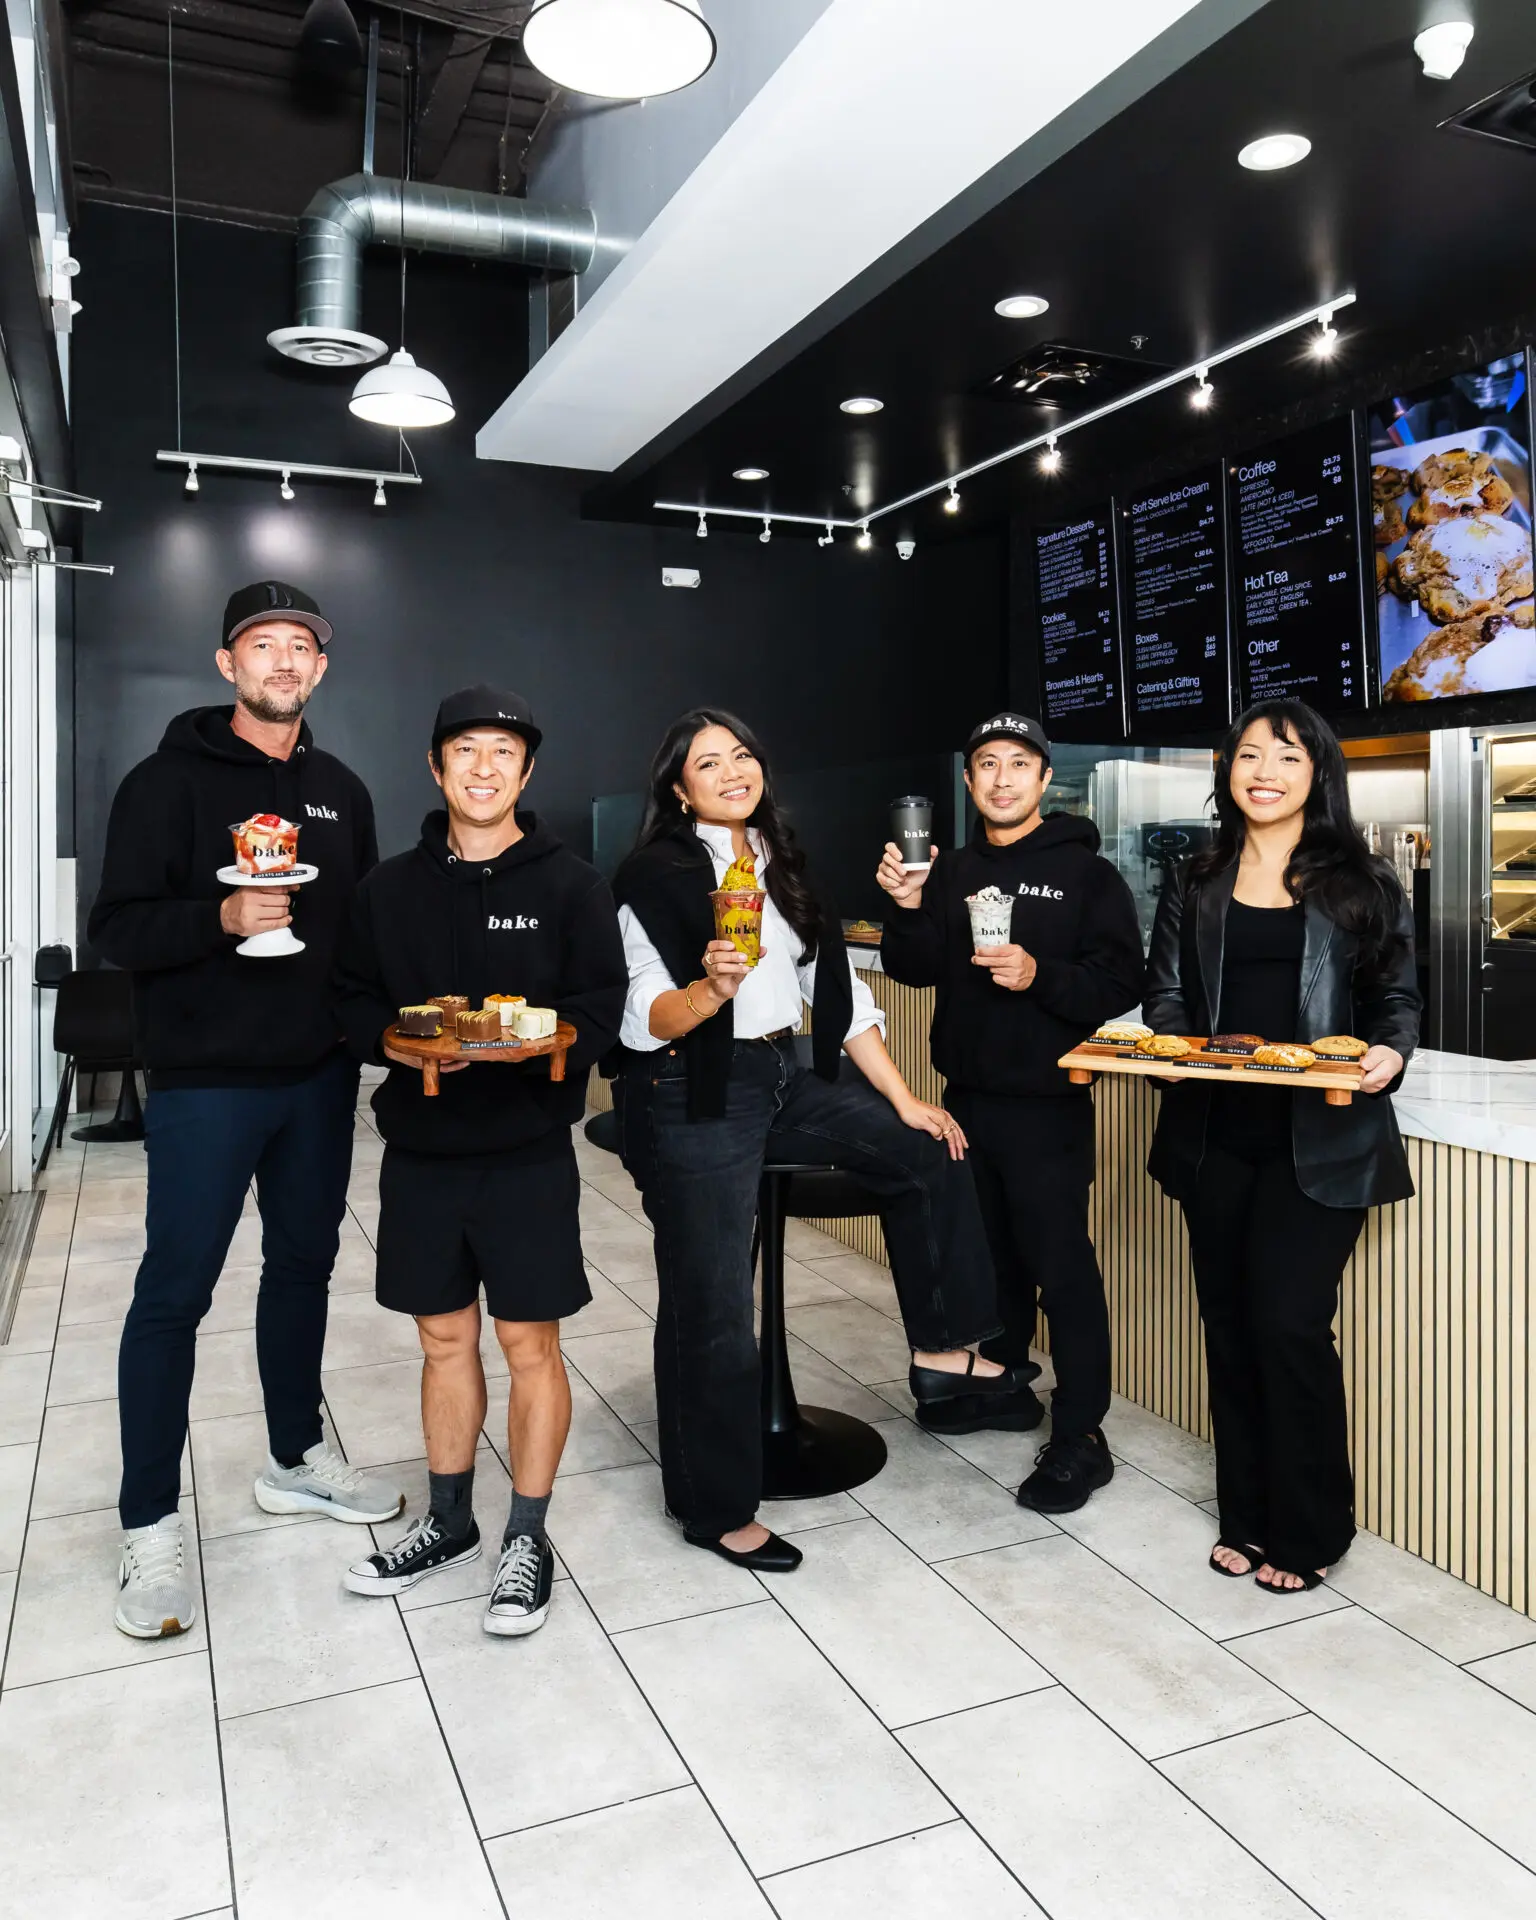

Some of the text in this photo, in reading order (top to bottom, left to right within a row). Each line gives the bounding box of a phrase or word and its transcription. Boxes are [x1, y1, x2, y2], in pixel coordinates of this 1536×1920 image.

[1323, 454, 1341, 467] $3.75
[1239, 460, 1277, 481] Coffee
[1322, 465, 1341, 477] $4.50
[1240, 479, 1269, 494] ESPRESSO
[1132, 482, 1210, 515] Soft Serve Ice Cream
[1241, 487, 1275, 502] AMERICANO
[1241, 502, 1256, 513] LATTE
[1257, 497, 1271, 510] (HOT
[1279, 489, 1295, 501] ICED)
[1037, 520, 1095, 546] Signature Desserts
[1244, 536, 1275, 550] AFFOGATO
[1245, 571, 1289, 591] Hot Tea
[1329, 572, 1347, 582] $5.50
[1280, 585, 1294, 594] CHAI
[1247, 601, 1262, 610] EARLY
[1281, 592, 1304, 602] ENGLISH
[1280, 602, 1298, 611] GREEN
[1041, 612, 1067, 625] Cookies
[1136, 633, 1159, 645] Boxes
[1248, 640, 1279, 655] Other
[1342, 642, 1350, 651] $3
[1249, 659, 1262, 667] MILK
[1341, 660, 1350, 668] $4
[1046, 673, 1104, 691] Brownies & Hearts
[1250, 674, 1269, 682] WATER
[1343, 678, 1352, 686] $6
[1137, 676, 1200, 694] Catering & Gifting
[1251, 688, 1287, 700] HOT COCOA
[1343, 689, 1352, 697] $6
[981, 717, 1029, 733] bake
[305, 804, 339, 821] bake
[904, 830, 930, 838] bake
[253, 844, 295, 857] bake
[1018, 883, 1064, 900] bake
[488, 915, 539, 929] bake
[725, 925, 758, 934] bake
[981, 928, 1009, 936] bake
